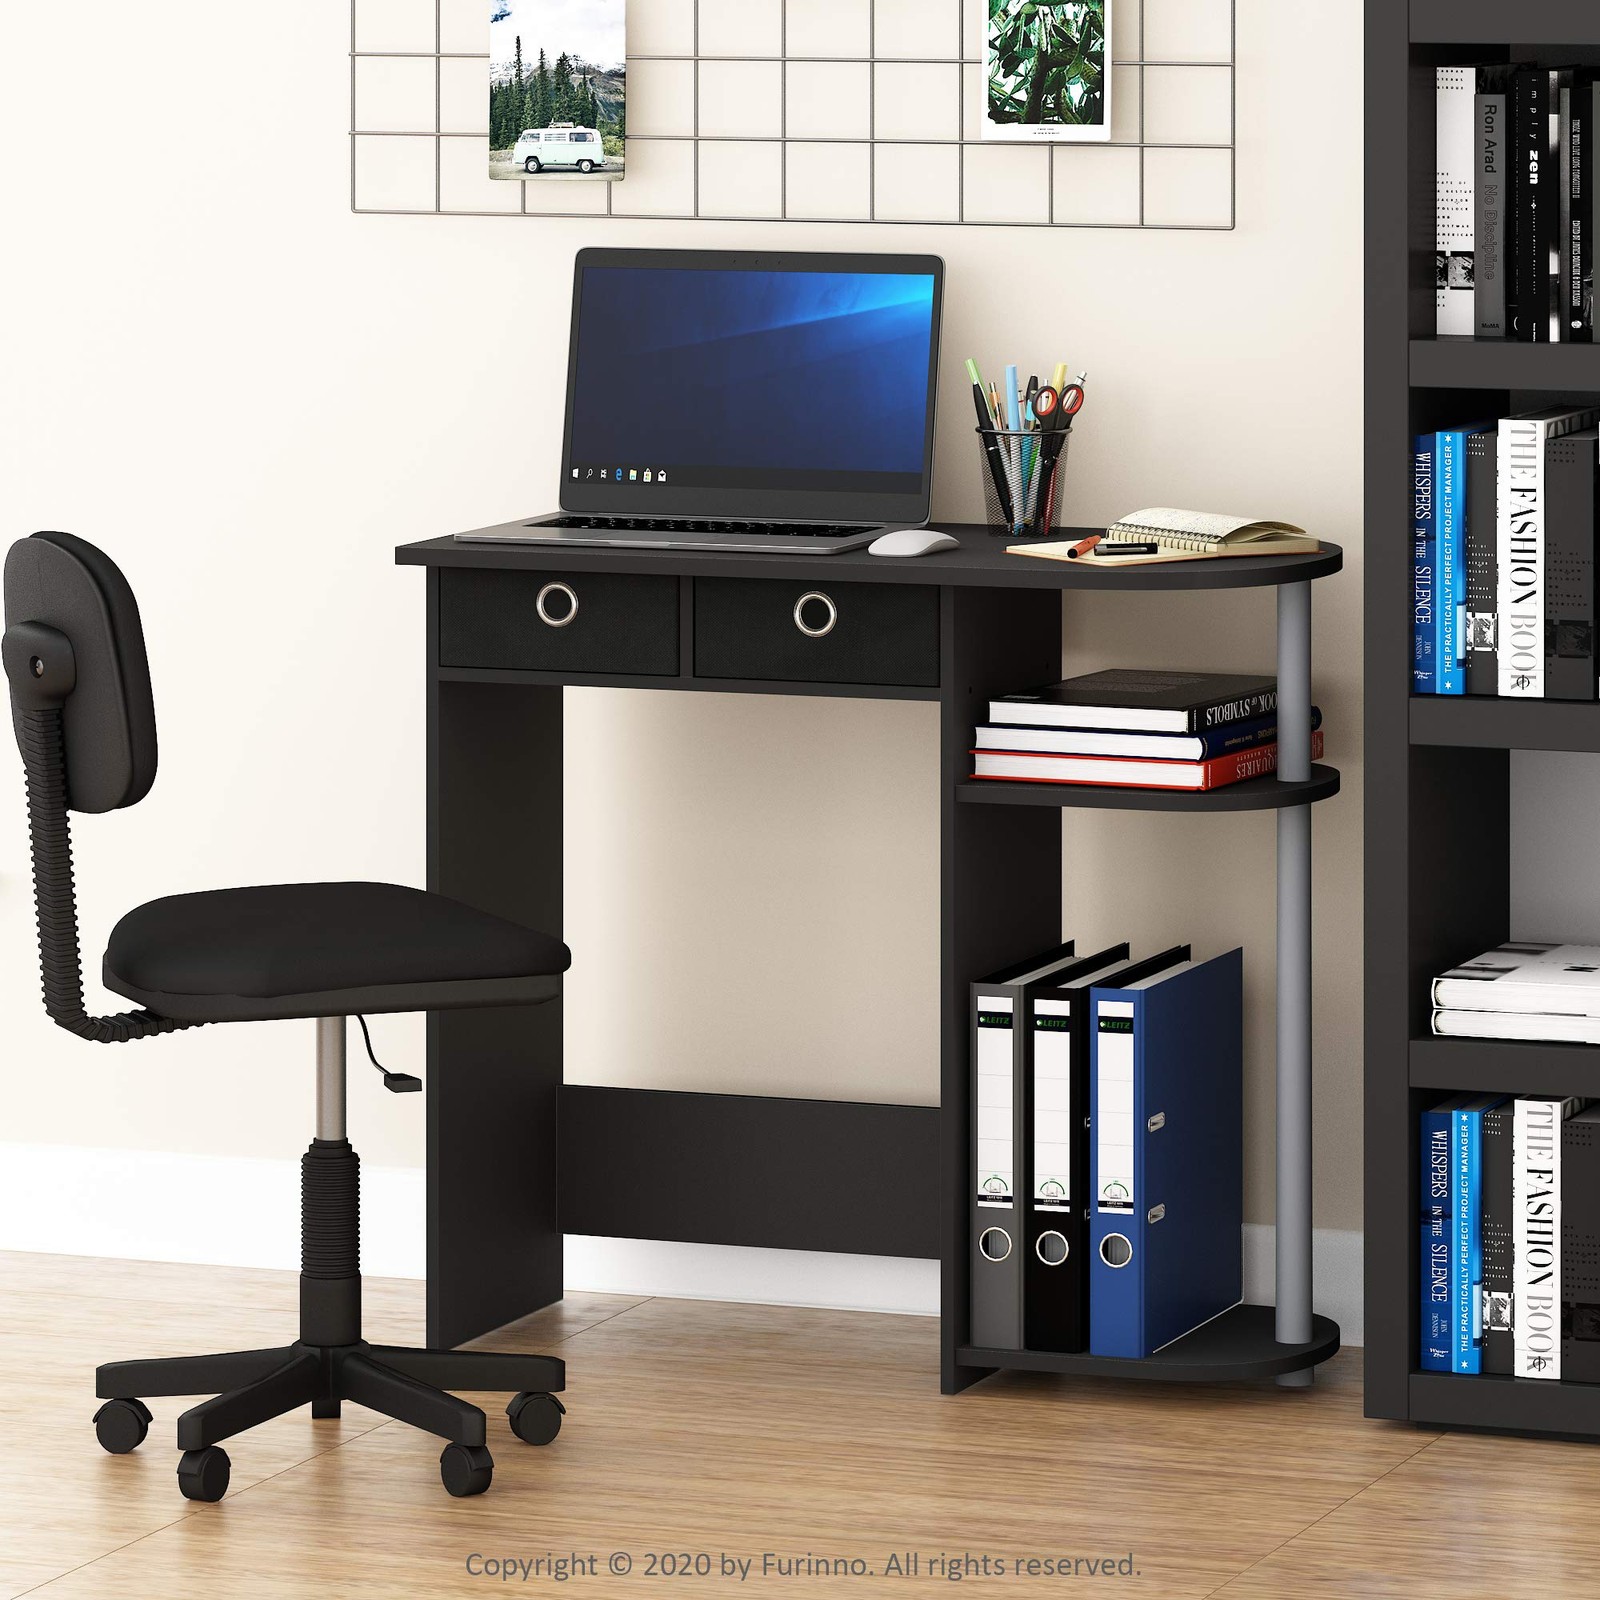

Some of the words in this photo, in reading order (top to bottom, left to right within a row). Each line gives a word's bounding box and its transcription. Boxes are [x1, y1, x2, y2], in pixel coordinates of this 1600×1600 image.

[1484, 104, 1498, 134] Ron
[1484, 138, 1498, 174] Arad
[1529, 150, 1539, 184] zen
[1484, 184, 1498, 206] No
[1482, 209, 1498, 281] Discipline
[1444, 445, 1452, 494] MANAGER
[1510, 422, 1537, 479] THE
[1415, 452, 1431, 520] WHISPERS
[1415, 527, 1426, 537] IN
[1444, 497, 1452, 540] PROJECT
[1415, 538, 1426, 559] THE
[1444, 541, 1452, 585] PERFECT
[1510, 486, 1538, 607] FASHION
[1415, 565, 1432, 624] SILENCE
[1444, 586, 1452, 655] PRACTICALLY
[1444, 655, 1452, 673] THE
[1510, 614, 1538, 690] BOOK
[1206, 698, 1251, 726] SYMBOLS
[1259, 691, 1278, 713] OOK
[1236, 753, 1278, 779] IQUAIRES
[986, 1016, 1010, 1025] LEITZ
[1043, 1019, 1067, 1028] LEITZ
[1107, 1022, 1131, 1030] LEITZ
[1460, 1125, 1469, 1173] MANAGER
[1526, 1104, 1554, 1161] THE
[1431, 1130, 1448, 1198] WHISPERS
[1431, 1205, 1443, 1216] IN
[1460, 1175, 1469, 1219] PROJECT
[1431, 1217, 1443, 1237] THE
[1460, 1221, 1469, 1264] PERFECT
[1526, 1167, 1554, 1289] FASHION
[1431, 1243, 1448, 1303] SILENCE
[1460, 1265, 1469, 1333] PRACTICALLY
[1460, 1334, 1469, 1352] THE
[1526, 1294, 1554, 1372] BOOK
